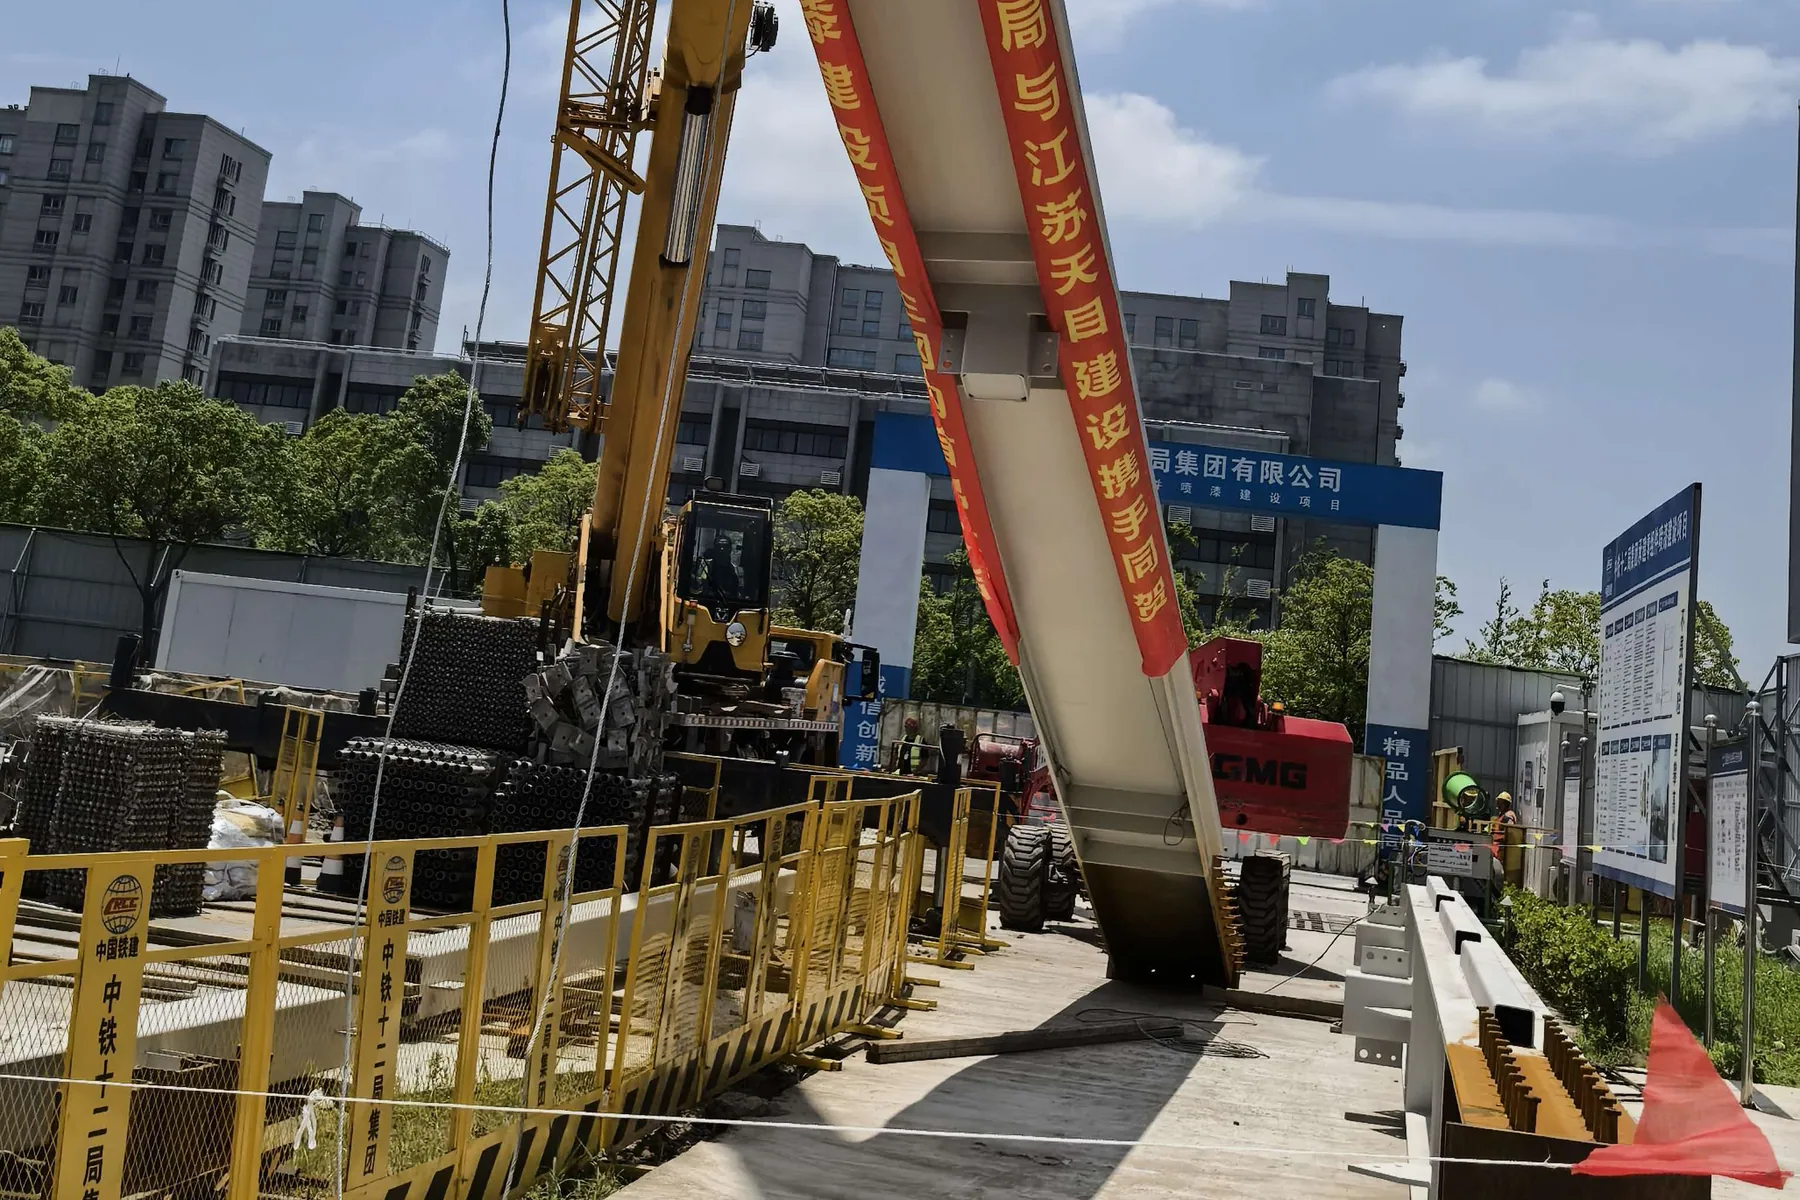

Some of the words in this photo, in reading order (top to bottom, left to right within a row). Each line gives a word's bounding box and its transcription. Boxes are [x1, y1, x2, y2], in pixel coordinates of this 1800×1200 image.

[1149, 447, 1342, 493] 局集团有限公司
[95, 935, 140, 963] 中国铁建
[363, 938, 395, 1176] 中铁十二局集团
